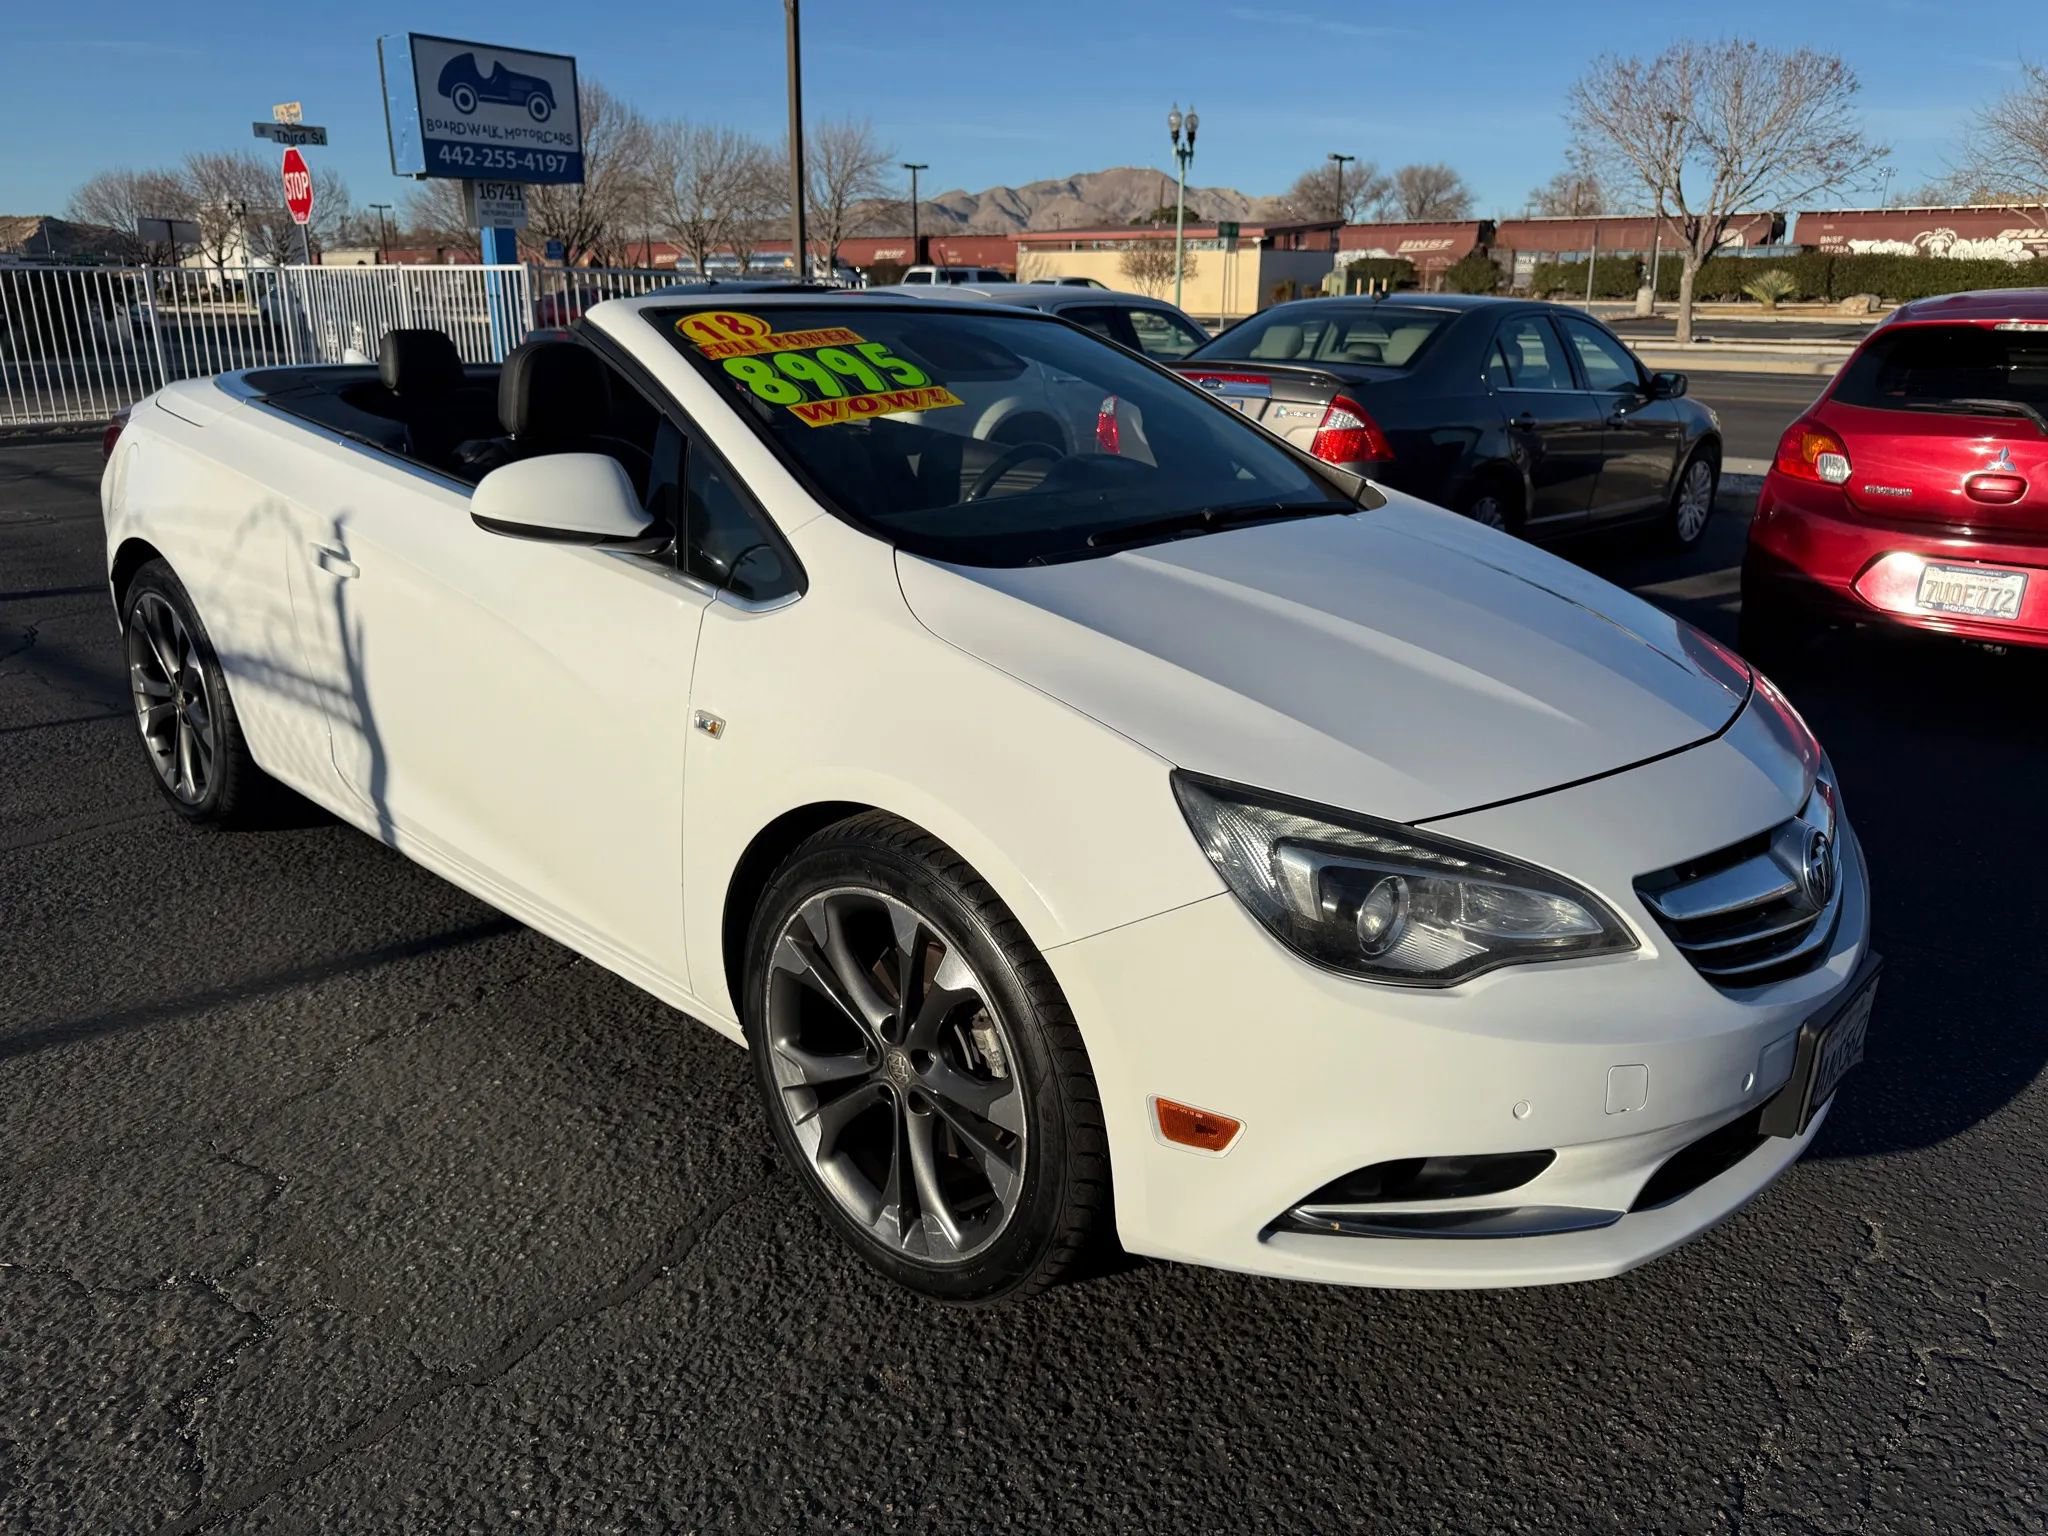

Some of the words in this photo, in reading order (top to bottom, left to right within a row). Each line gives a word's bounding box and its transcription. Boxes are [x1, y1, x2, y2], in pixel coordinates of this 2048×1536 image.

[274, 130, 306, 144] Third
[311, 132, 324, 145] St
[425, 118, 504, 139] BOARDWALK
[504, 128, 574, 146] MOTORCARS
[438, 145, 568, 173] 442-255-4197
[284, 171, 309, 201] STOP
[478, 182, 522, 201] 16741
[1398, 239, 1455, 251] BNSF
[692, 314, 756, 341] 18
[701, 341, 764, 358] FULL
[770, 329, 858, 349] POWER
[722, 342, 933, 406] 8995
